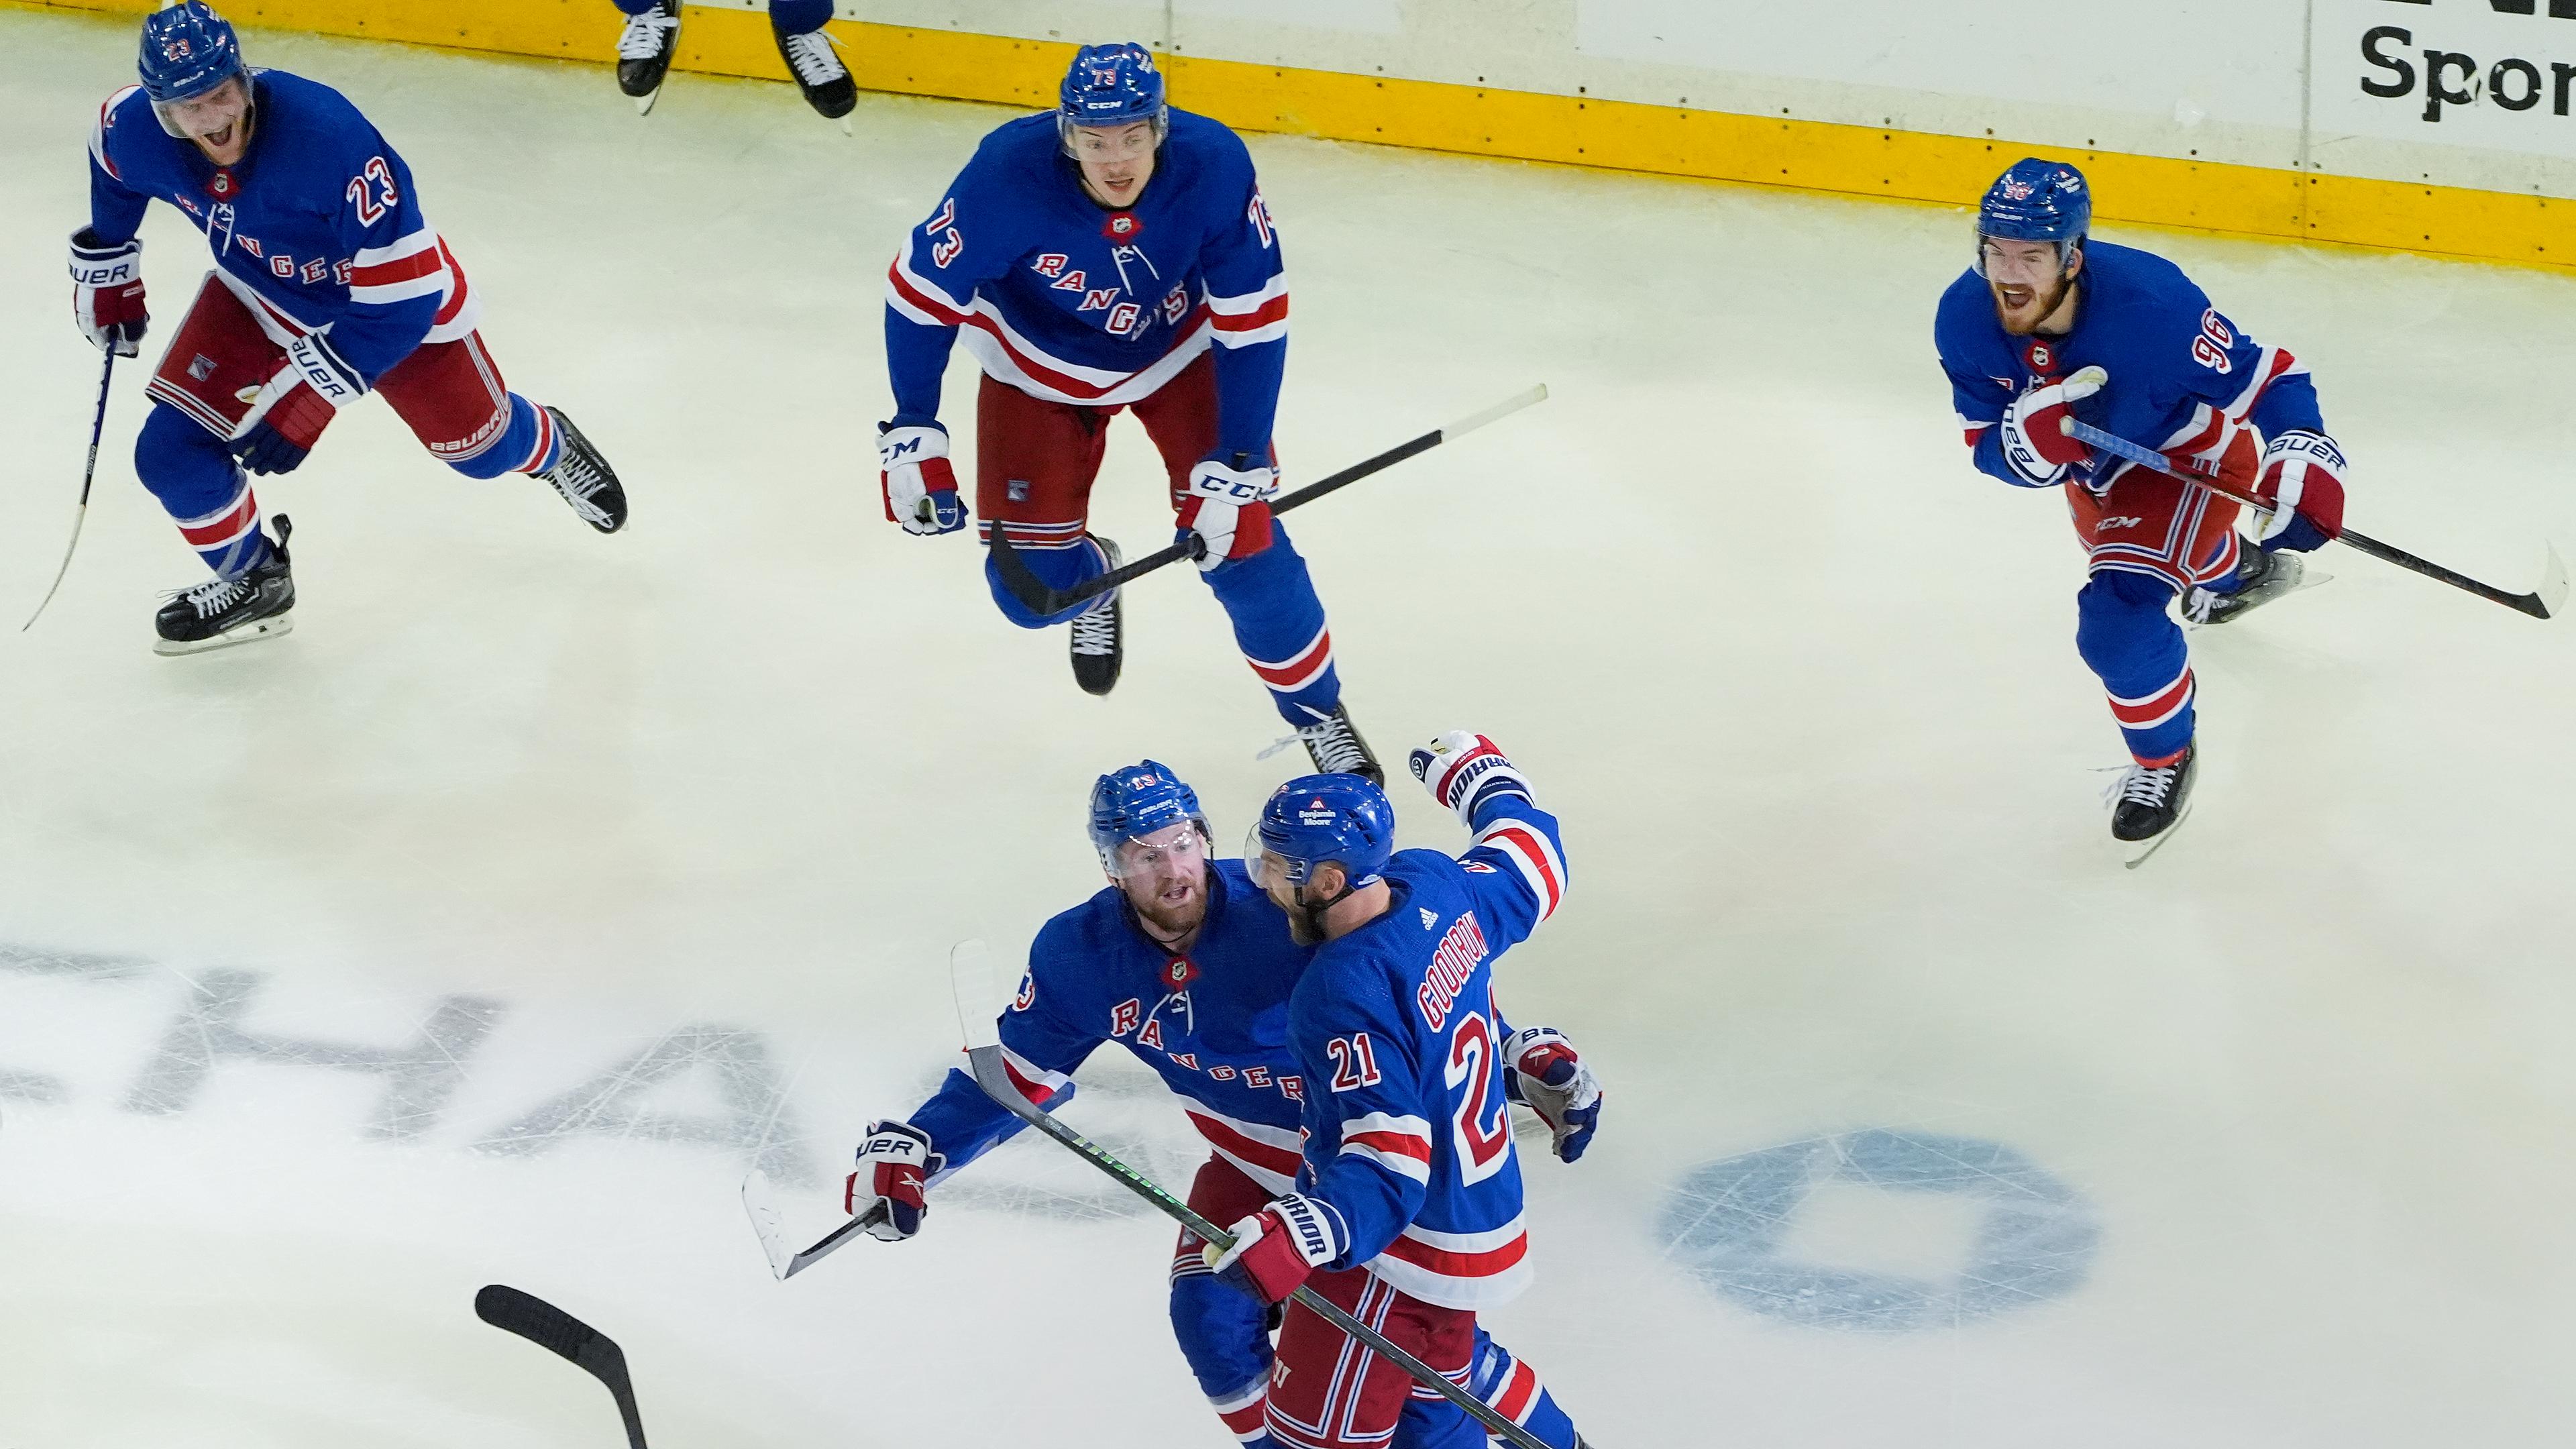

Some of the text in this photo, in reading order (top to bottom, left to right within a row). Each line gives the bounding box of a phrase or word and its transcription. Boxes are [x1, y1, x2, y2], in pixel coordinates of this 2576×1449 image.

[166, 38, 191, 62] 23
[1090, 68, 1117, 86] 73
[1086, 101, 1123, 110] CCM
[345, 155, 398, 228] 23
[926, 197, 963, 269] 73
[2191, 307, 2234, 375] 96
[1299, 810, 1336, 819] Benjamin
[1303, 818, 1332, 826] Moore
[1417, 910, 1490, 1033] GOODROW
[1326, 1032, 1382, 1093] 21
